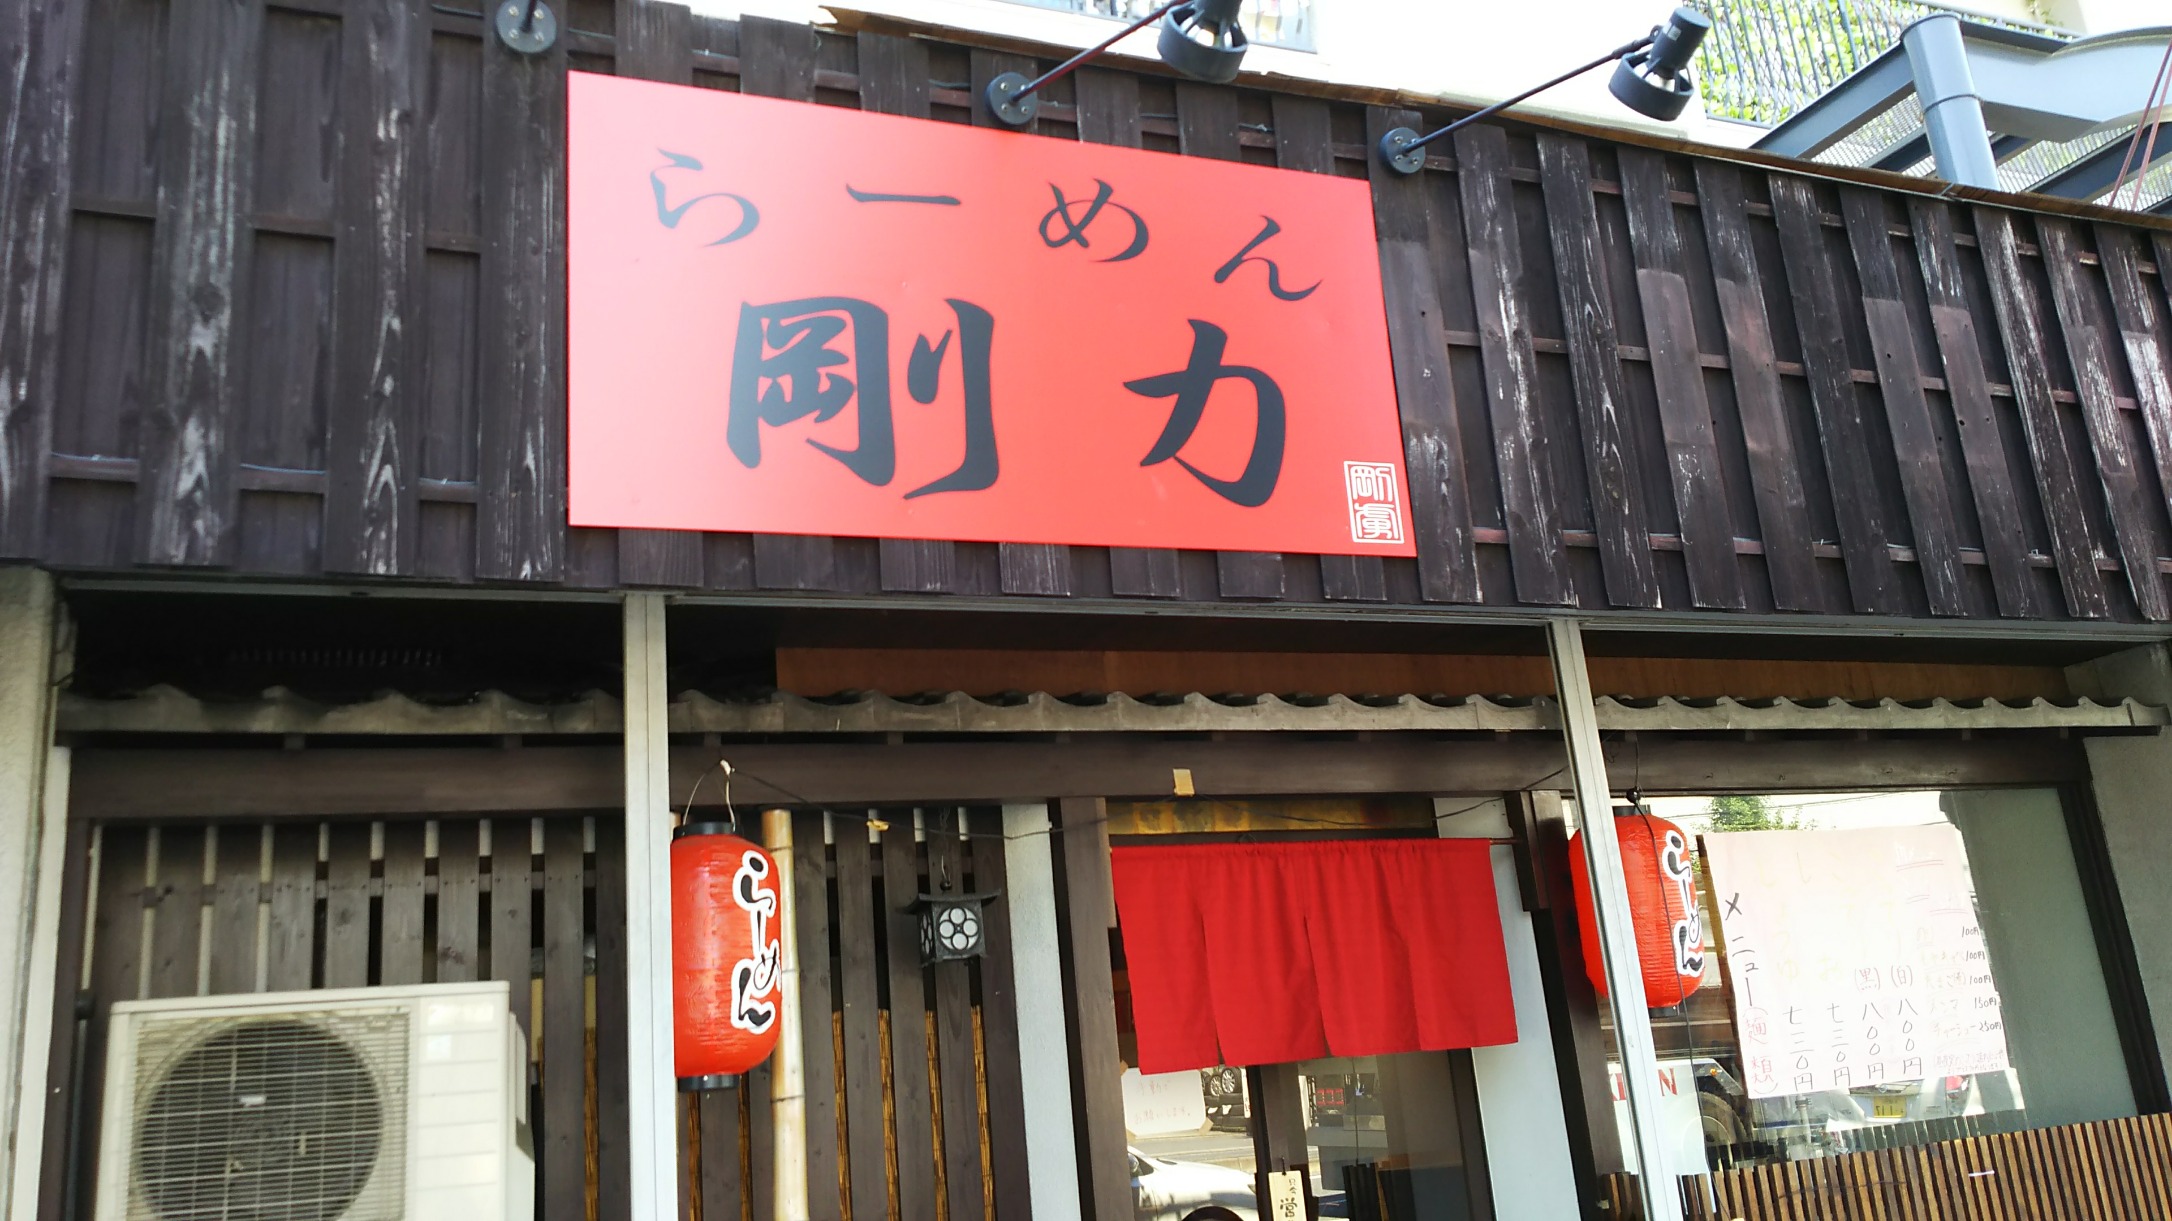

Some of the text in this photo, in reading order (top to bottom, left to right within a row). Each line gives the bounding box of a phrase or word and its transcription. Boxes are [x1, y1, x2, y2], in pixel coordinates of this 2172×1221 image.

[648, 147, 1323, 303] らーめん
[725, 296, 1287, 508] 剛力
[733, 850, 781, 1033] らーめん
